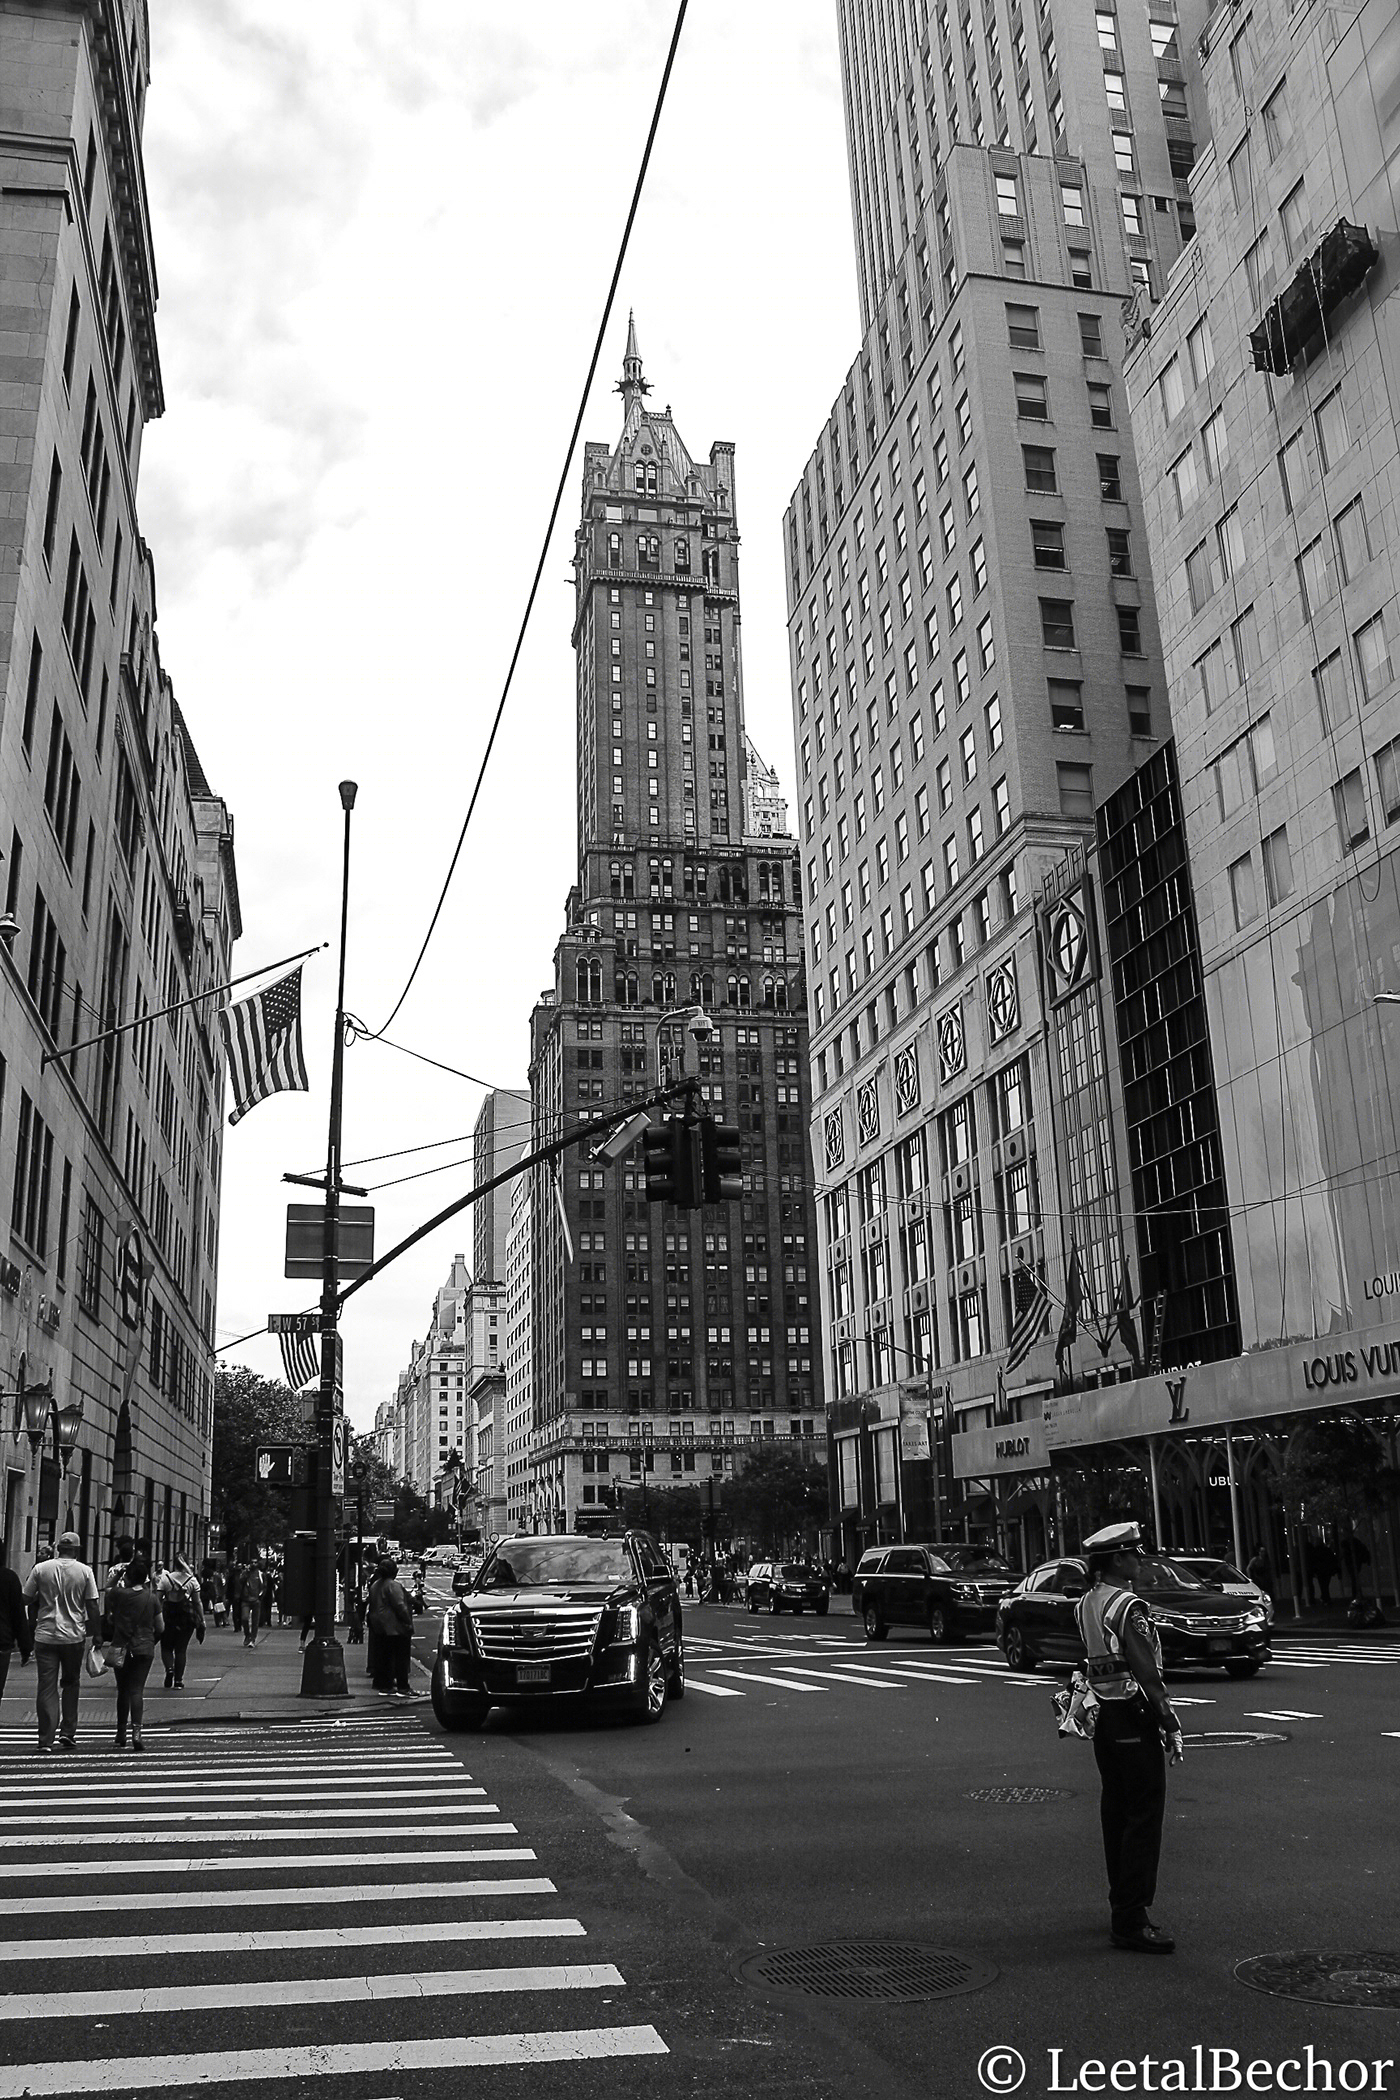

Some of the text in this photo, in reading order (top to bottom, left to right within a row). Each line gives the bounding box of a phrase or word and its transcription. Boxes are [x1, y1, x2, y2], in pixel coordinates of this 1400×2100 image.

[1363, 1271, 1400, 1301] LOUI
[282, 1317, 292, 1331] W
[296, 1316, 308, 1331] 57
[1302, 1351, 1358, 1389] LOUIS
[995, 1436, 1030, 1459] HUBLOT
